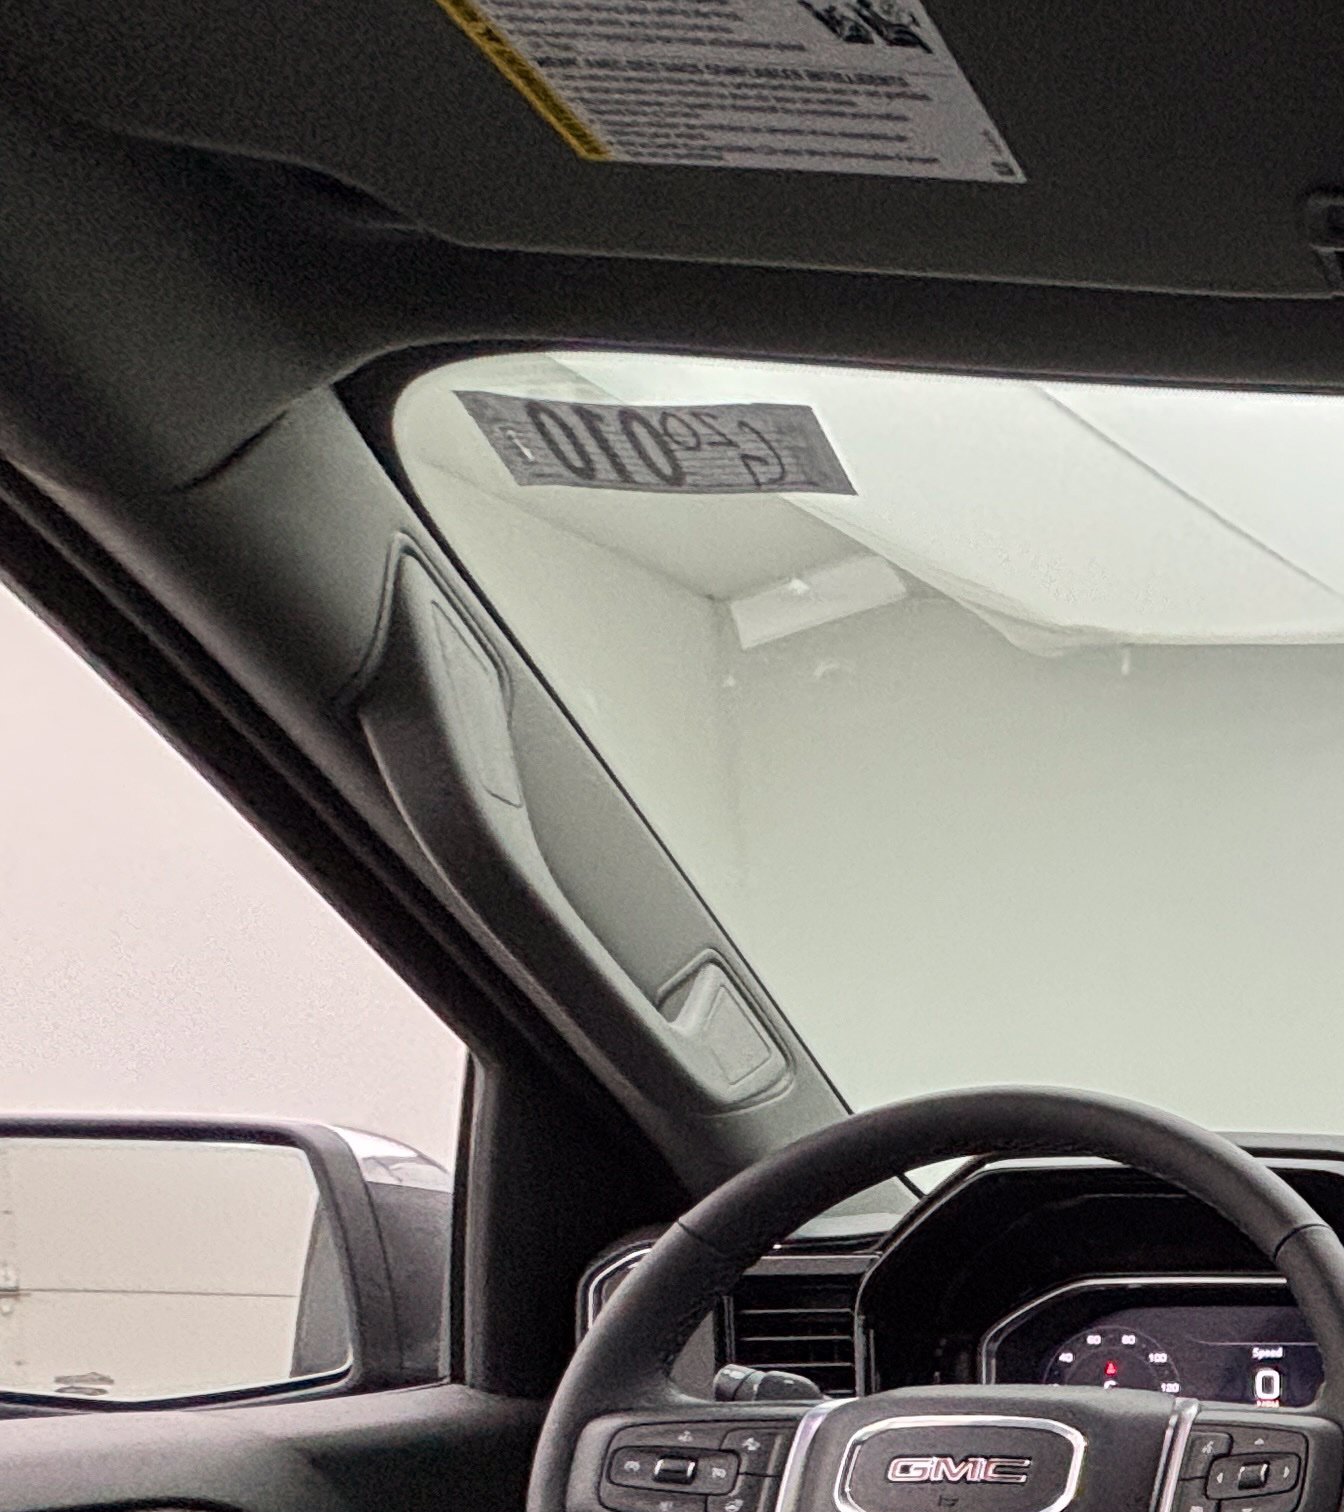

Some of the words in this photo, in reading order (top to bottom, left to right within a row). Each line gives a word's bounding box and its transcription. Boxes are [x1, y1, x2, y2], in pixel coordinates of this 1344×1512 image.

[1252, 1346, 1283, 1360] Speed
[1255, 1367, 1281, 1400] 0
[887, 1456, 1032, 1484] GMC
